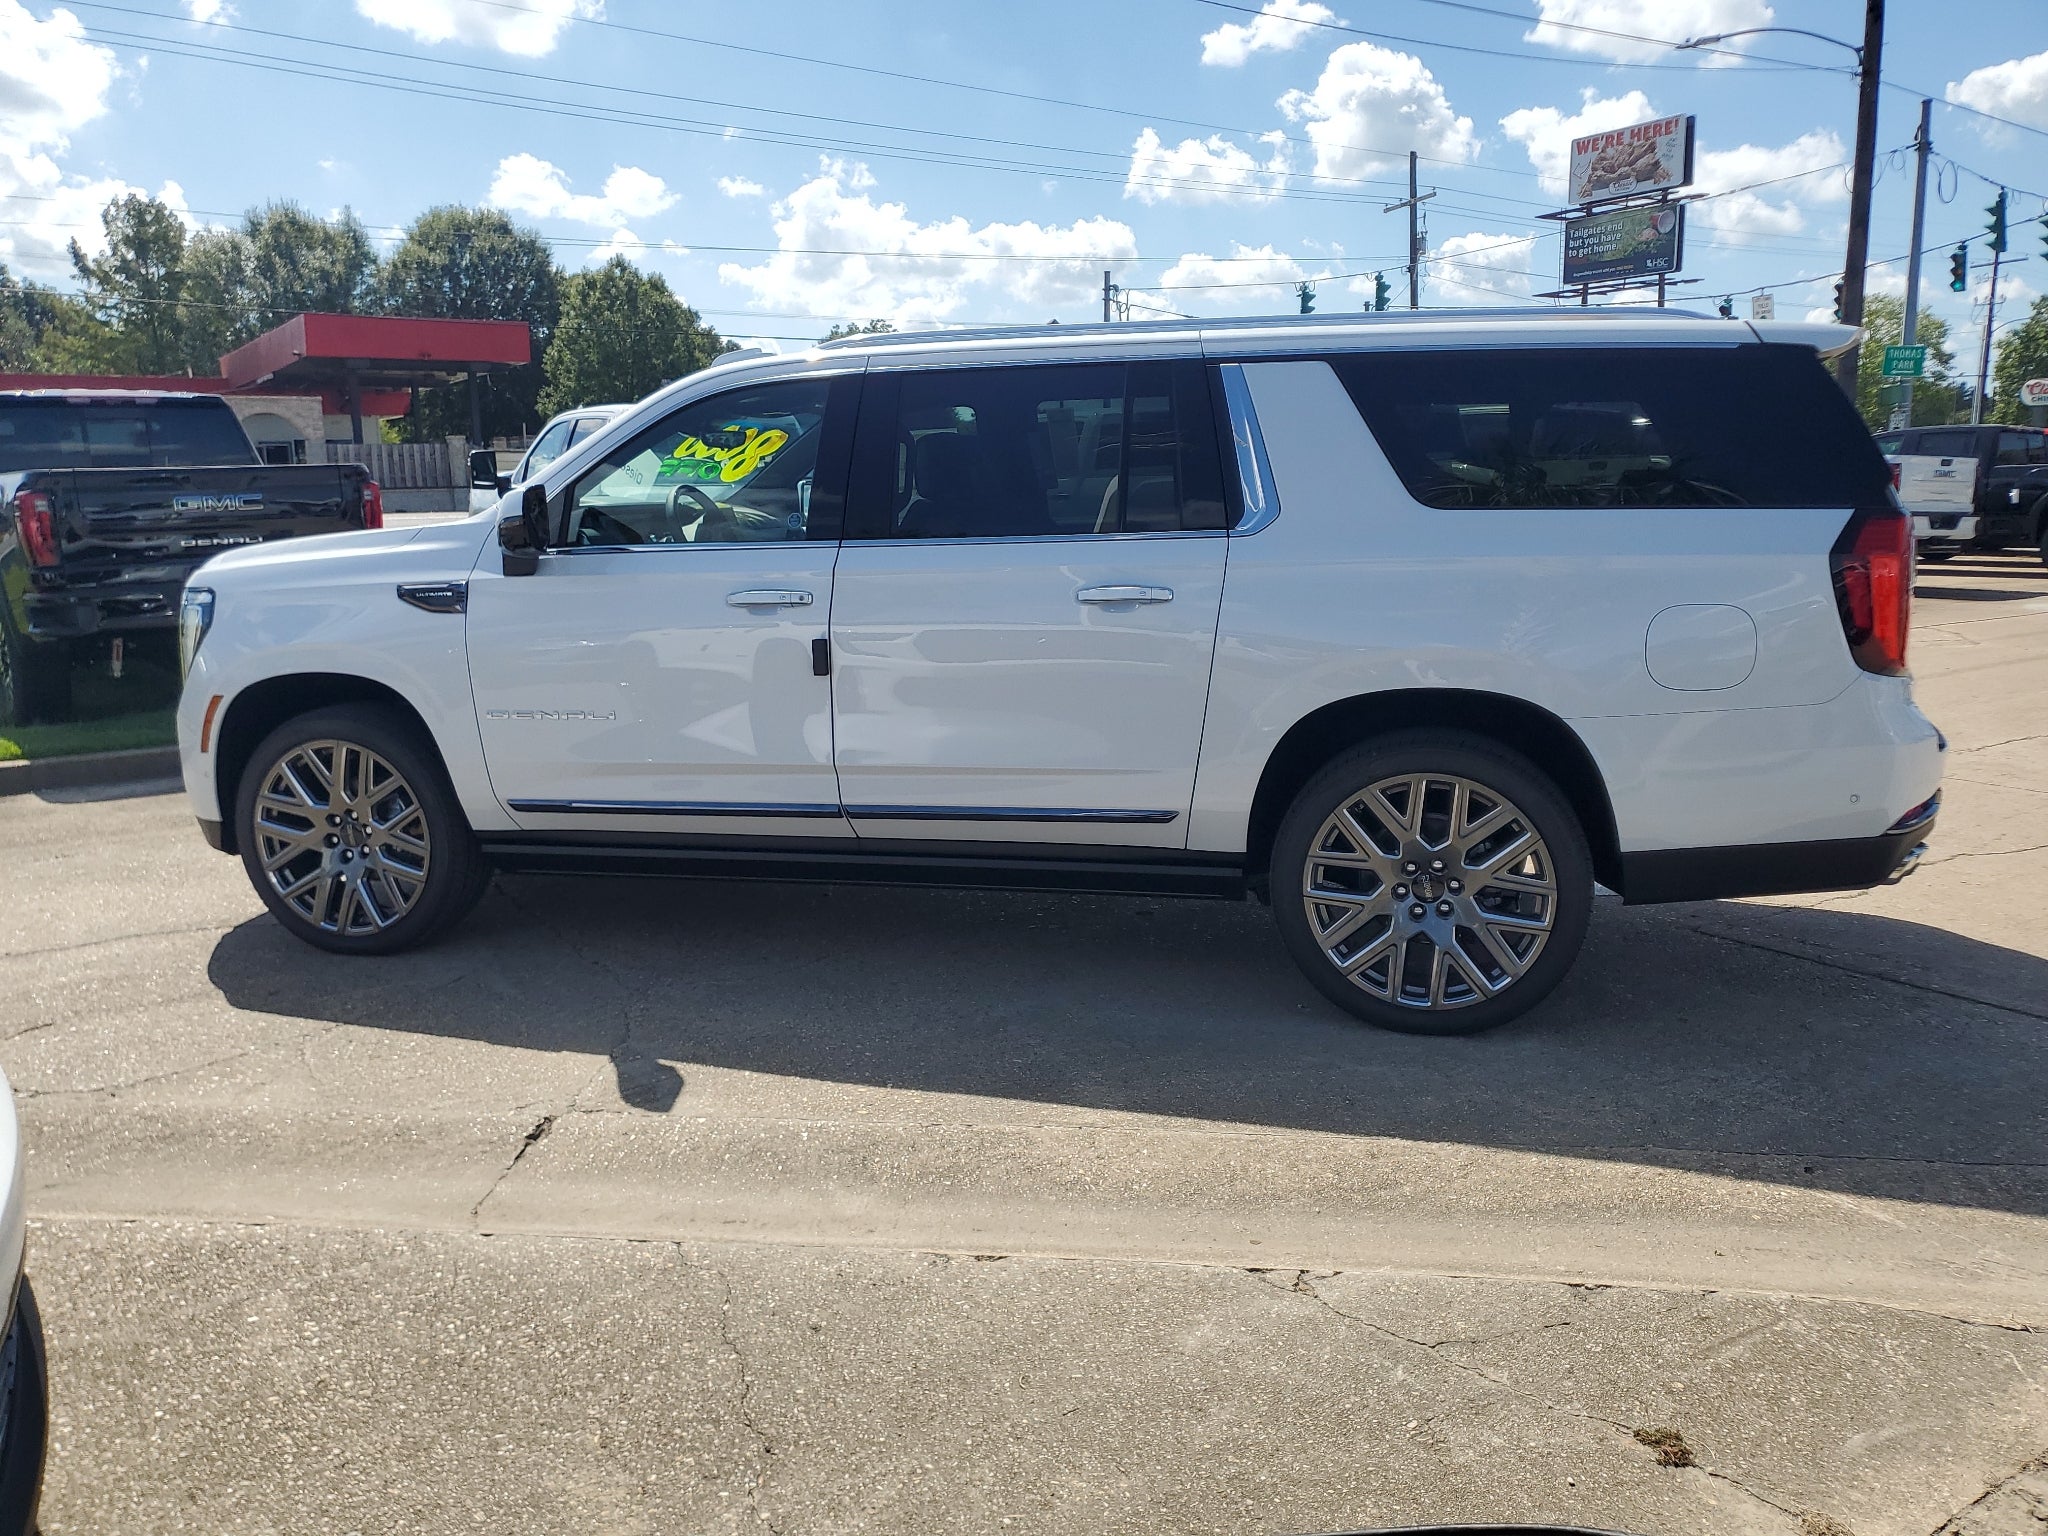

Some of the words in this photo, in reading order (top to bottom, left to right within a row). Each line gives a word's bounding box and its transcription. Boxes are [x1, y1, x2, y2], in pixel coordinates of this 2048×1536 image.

[1576, 132, 1625, 156] WE'RE
[1630, 118, 1680, 142] HERE!
[1569, 225, 1606, 239] Tailgates
[1607, 221, 1623, 231] end
[1569, 238, 1583, 248] but
[1584, 236, 1599, 247] you
[1601, 233, 1622, 243] have
[1568, 248, 1577, 257] to
[1578, 246, 1592, 258] get
[1888, 349, 1922, 358] THOMAS
[1893, 360, 1914, 369] PARK
[1934, 469, 1957, 478] GMC
[174, 493, 264, 513] GMC
[181, 536, 263, 547] DENALI
[486, 709, 617, 721] DENALI
